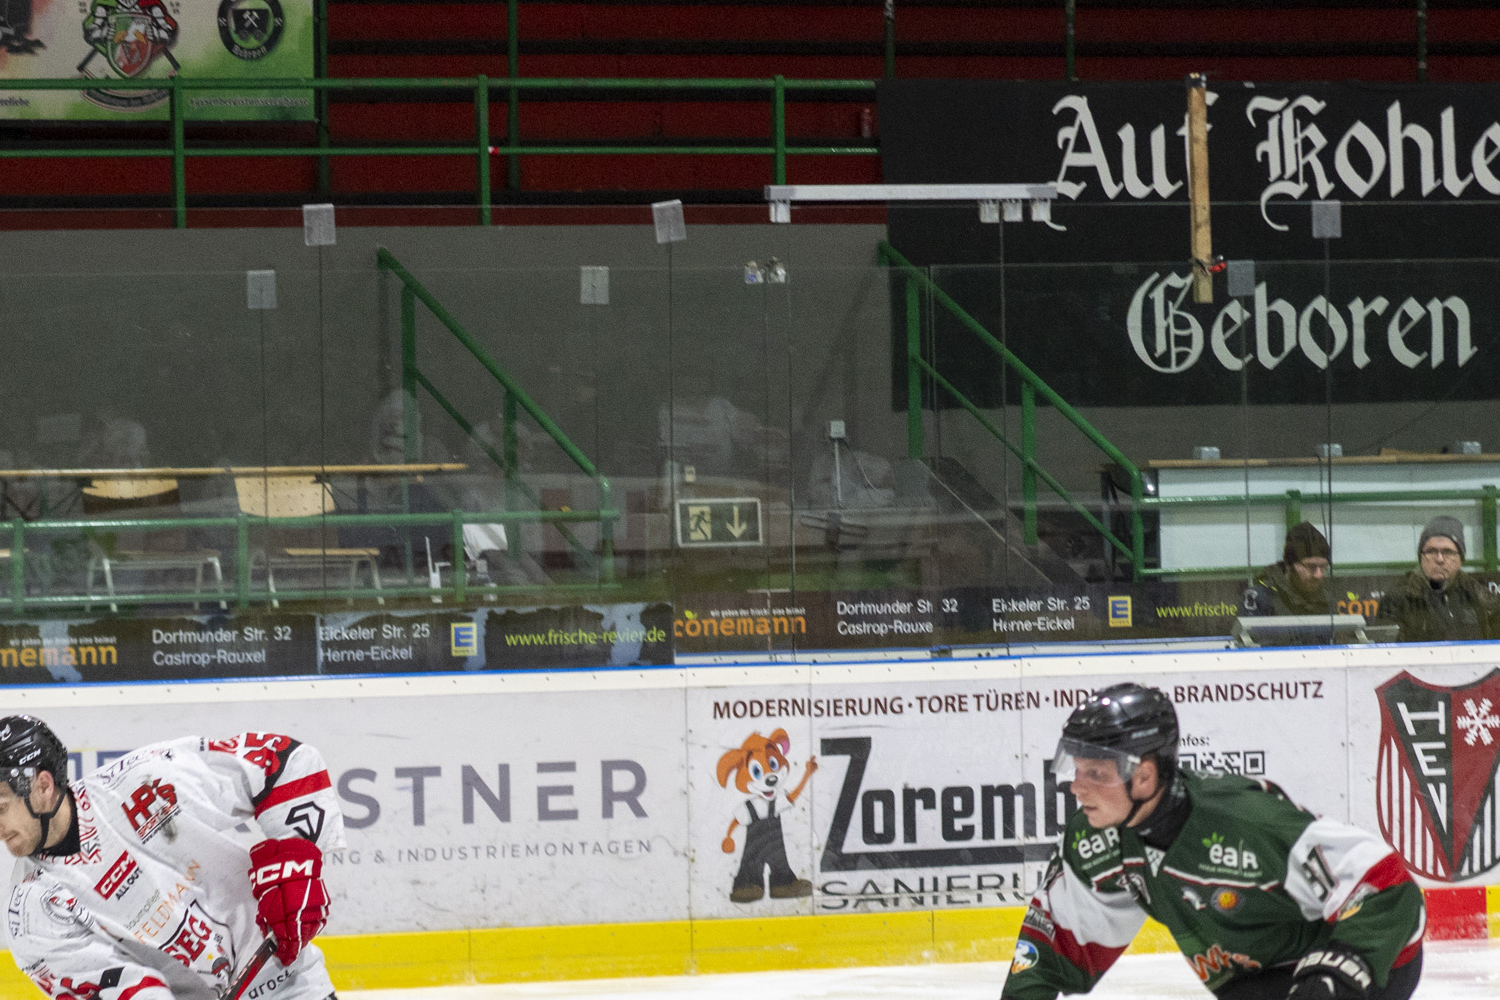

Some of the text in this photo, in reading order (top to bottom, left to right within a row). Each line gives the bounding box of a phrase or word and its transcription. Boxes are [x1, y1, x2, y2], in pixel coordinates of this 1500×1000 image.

[1127, 270, 1478, 374] Geboren
[836, 600, 914, 616] Dortmunder
[942, 598, 958, 613] 32
[1047, 597, 1070, 612] Str.
[1074, 596, 1091, 611] 25
[1157, 601, 1238, 619] www.frische
[152, 625, 292, 646] Dortmunder Str. 32
[319, 622, 431, 643] Eickeler Str. 25
[505, 625, 666, 648] www.frische-revier.de
[837, 620, 933, 636] Castrop-Rauxe
[153, 647, 266, 667] Castrop-Rauxel
[318, 645, 413, 664] Herne-Eickel
[713, 697, 904, 720] MODERNISIERUNG
[915, 694, 969, 714] TORE
[971, 688, 1041, 713] TÜREN
[1174, 681, 1324, 703] BRANDSCHUTZ
[1178, 736, 1211, 749] nfos:
[336, 759, 650, 830] STNER
[820, 736, 1077, 872] Zoremb
[322, 838, 653, 867] ING & INDUSTRIEMONTAGEN
[821, 869, 1043, 910] SANIERU
